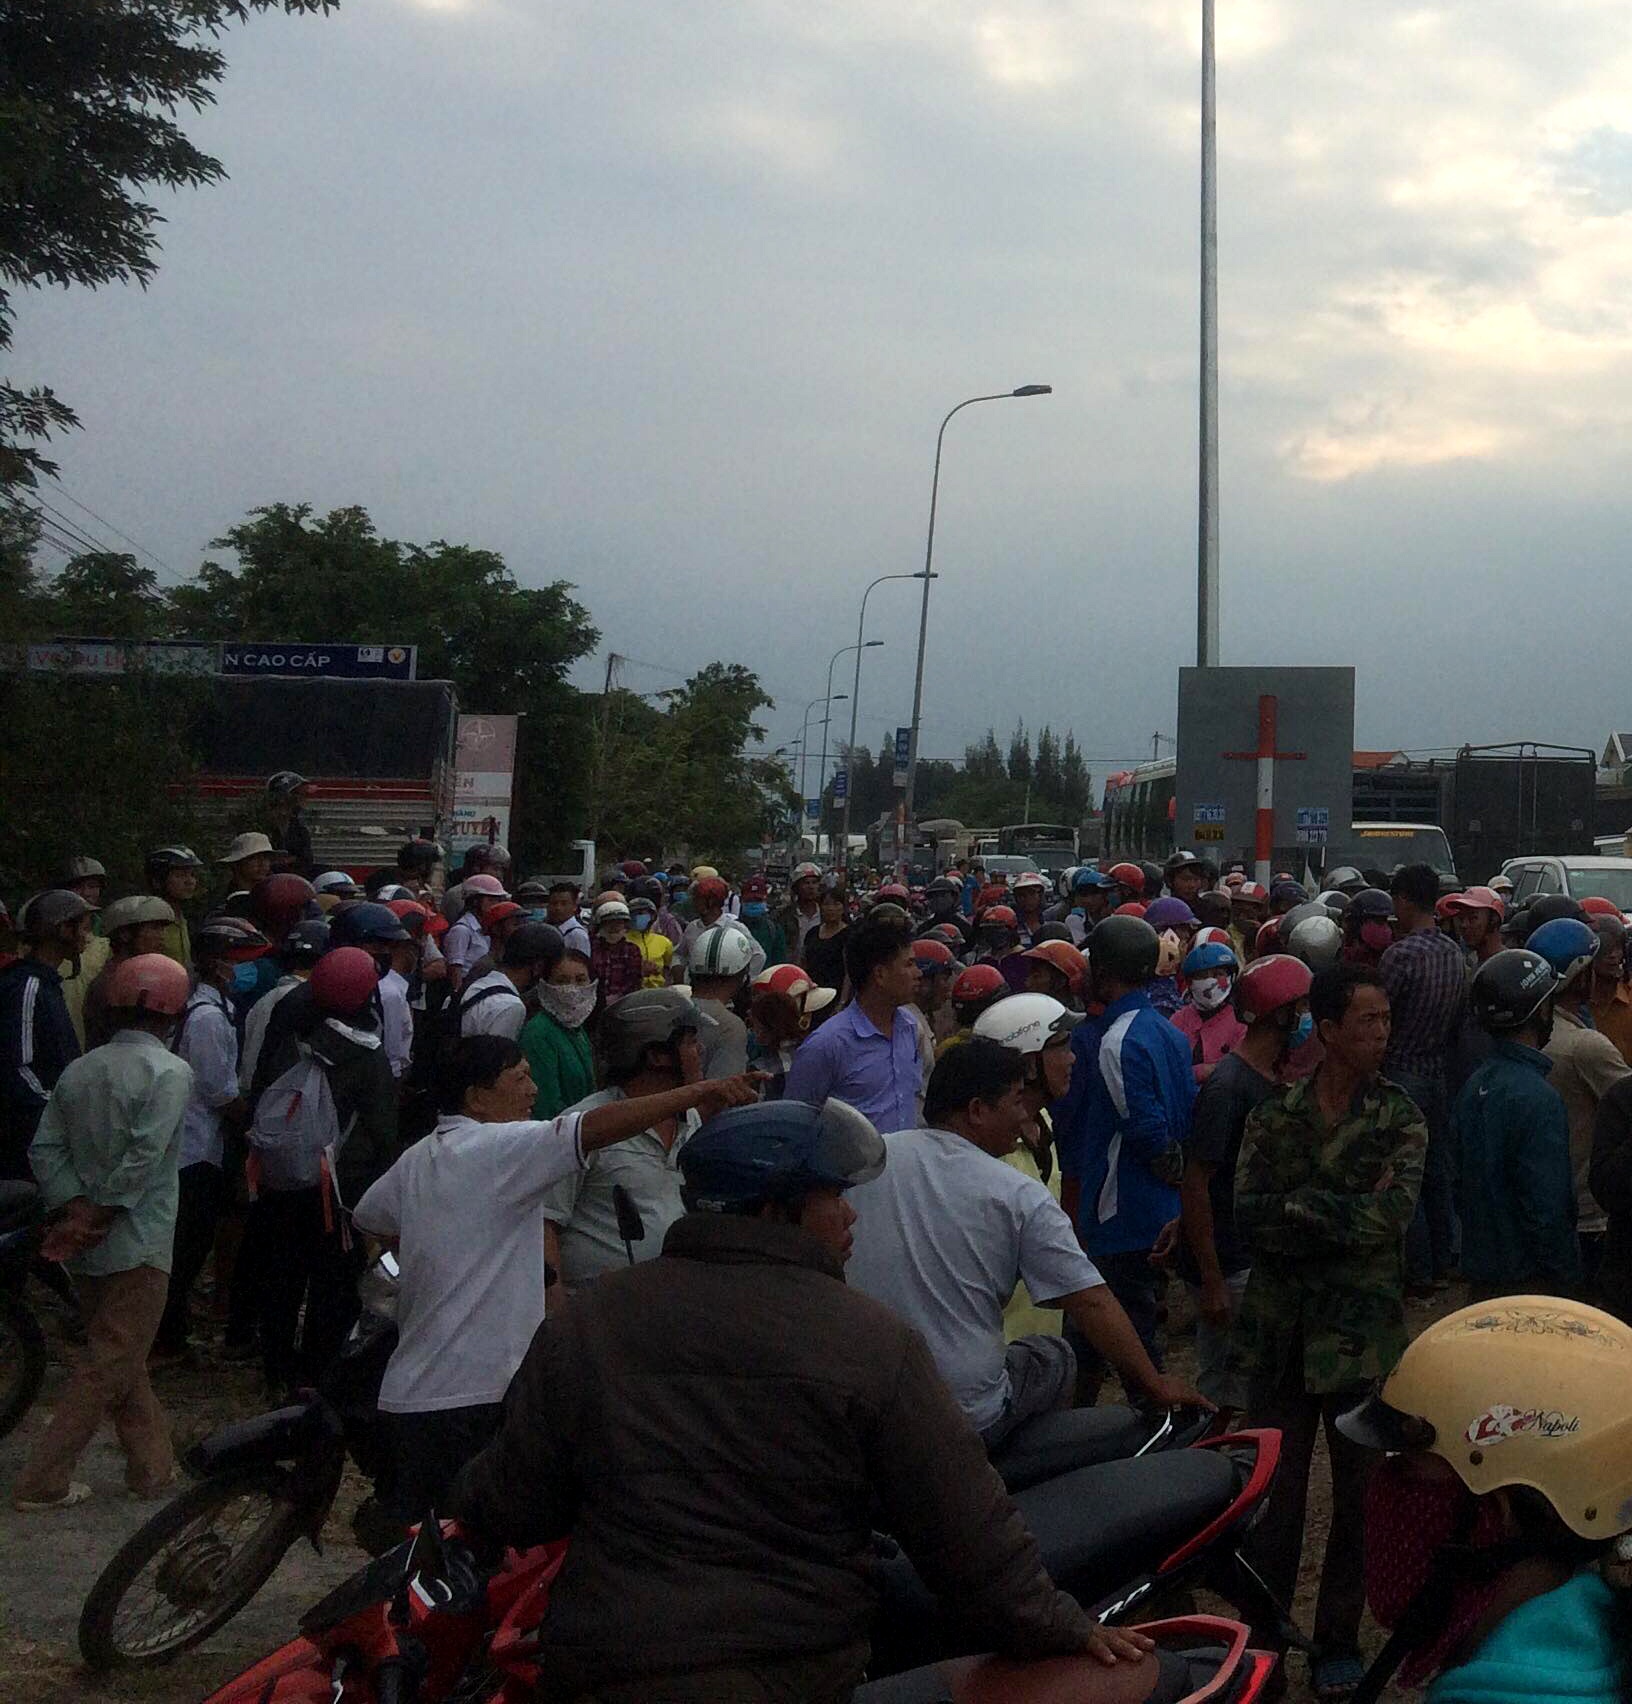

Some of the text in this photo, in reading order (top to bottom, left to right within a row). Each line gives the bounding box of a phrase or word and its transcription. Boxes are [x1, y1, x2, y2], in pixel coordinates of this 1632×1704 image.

[244, 654, 286, 667] CAO
[290, 651, 331, 667] CẤP
[1000, 1020, 1041, 1044] odafone
[1521, 1408, 1580, 1438] Napoli
